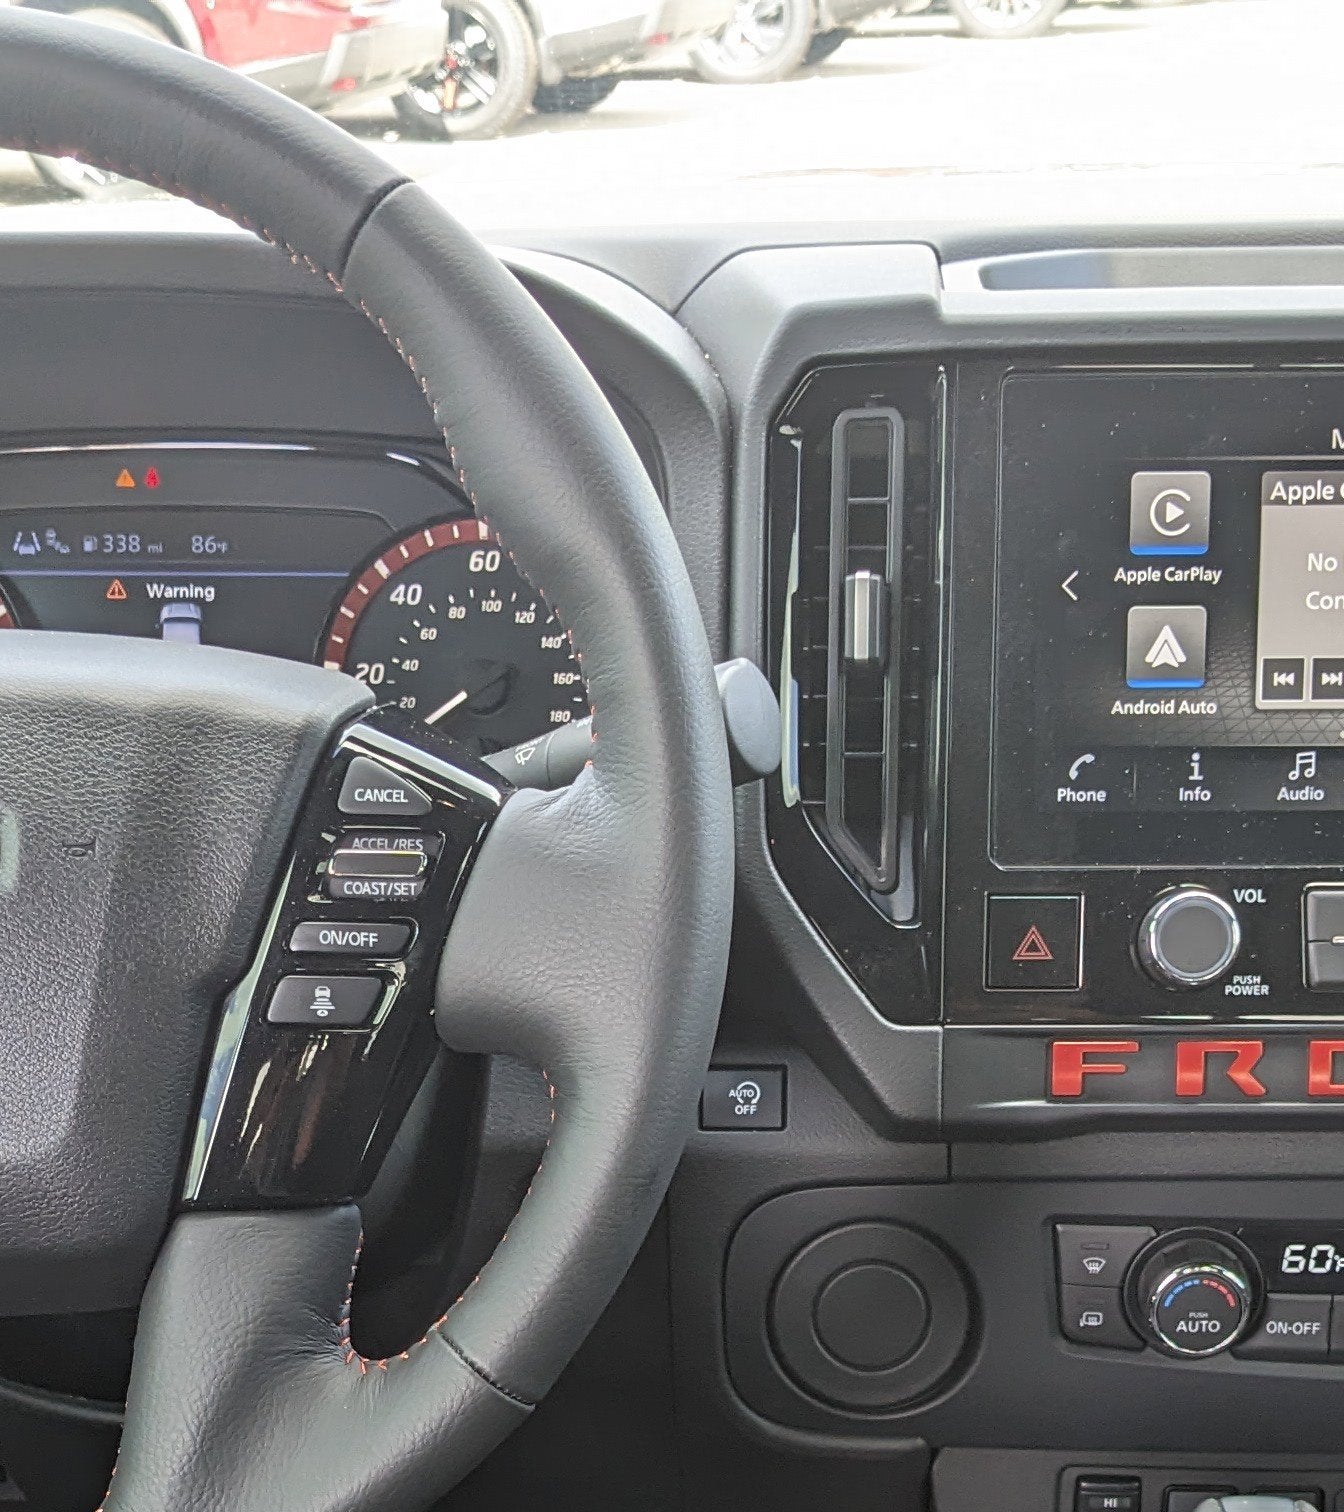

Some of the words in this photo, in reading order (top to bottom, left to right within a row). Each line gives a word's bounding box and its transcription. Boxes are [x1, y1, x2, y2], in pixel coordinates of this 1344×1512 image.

[1270, 481, 1335, 505] Apple
[103, 534, 141, 554] 338
[468, 550, 501, 573] 60
[1307, 552, 1339, 572] No
[1114, 566, 1160, 585] Apple
[1163, 565, 1223, 584] CarPlay
[146, 582, 215, 602] Warning
[389, 583, 423, 607] 40
[448, 606, 466, 619] 80
[480, 600, 503, 613] 100
[514, 611, 536, 624] 120
[419, 627, 437, 641] 60
[540, 636, 562, 650] 140
[401, 658, 419, 672] 40
[355, 663, 385, 687] 20
[553, 672, 575, 686] 160
[399, 696, 416, 709] 20
[1111, 698, 1175, 716] Android
[1178, 699, 1218, 716] Auto
[549, 710, 571, 723] 180
[354, 787, 408, 804] CANCEL
[1056, 787, 1107, 803] Phone
[1178, 787, 1211, 803] Info
[1277, 785, 1325, 802] Audio
[352, 837, 424, 852] ACCEL/RES
[344, 881, 417, 897] COAST/SET
[1233, 889, 1267, 904] VOL
[319, 929, 379, 948] ON/OFF
[1233, 975, 1262, 986] PUSH
[1224, 984, 1270, 997] POWER
[728, 1088, 755, 1098] AUTO
[734, 1104, 757, 1115] OFF
[1175, 1320, 1221, 1334] AUTO
[1266, 1321, 1321, 1336] ON-OFF
[1103, 1498, 1118, 1508] HI
